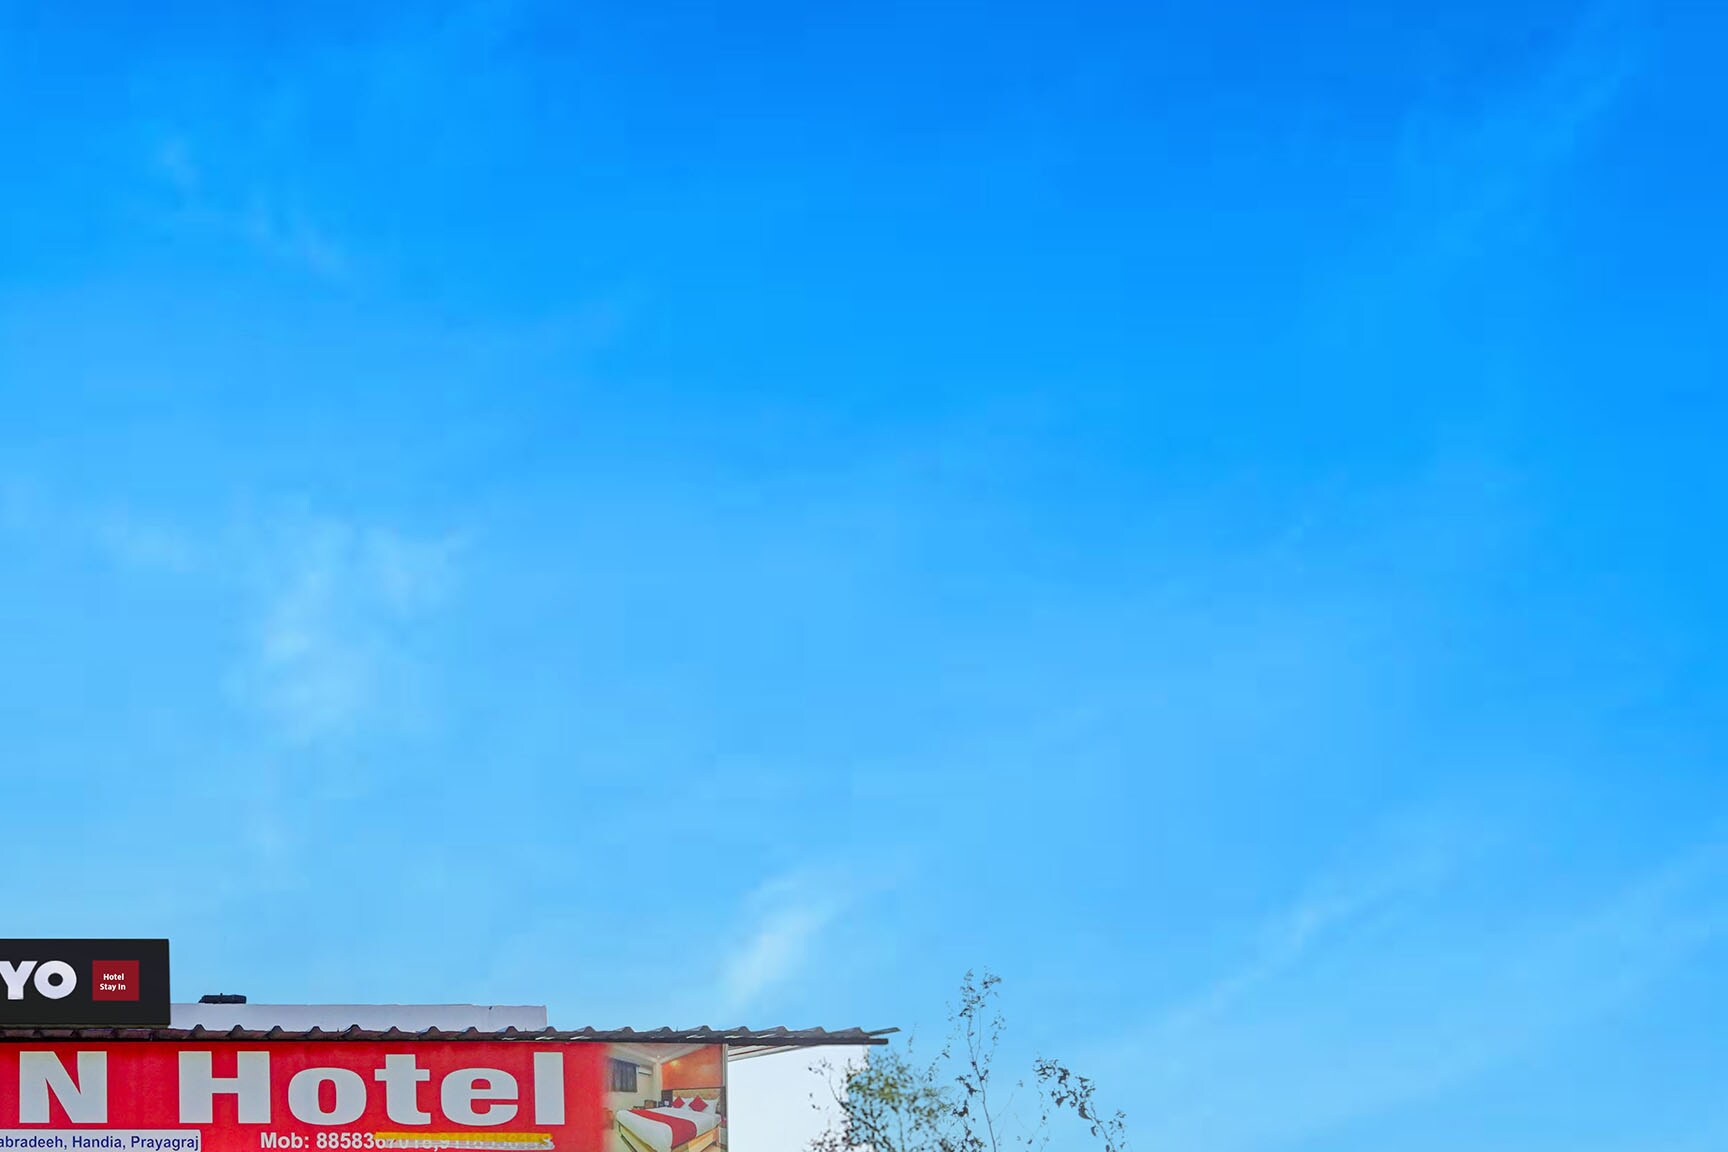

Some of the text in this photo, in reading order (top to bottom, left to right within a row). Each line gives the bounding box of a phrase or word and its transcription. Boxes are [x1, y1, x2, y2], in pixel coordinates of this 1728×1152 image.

[103, 973, 125, 981] Hotel
[99, 983, 126, 992] Stay In
[178, 1051, 565, 1126] Hotel
[72, 1136, 126, 1150] Handia,
[131, 1136, 200, 1152] Prayagraj
[260, 1132, 309, 1149] Mob:
